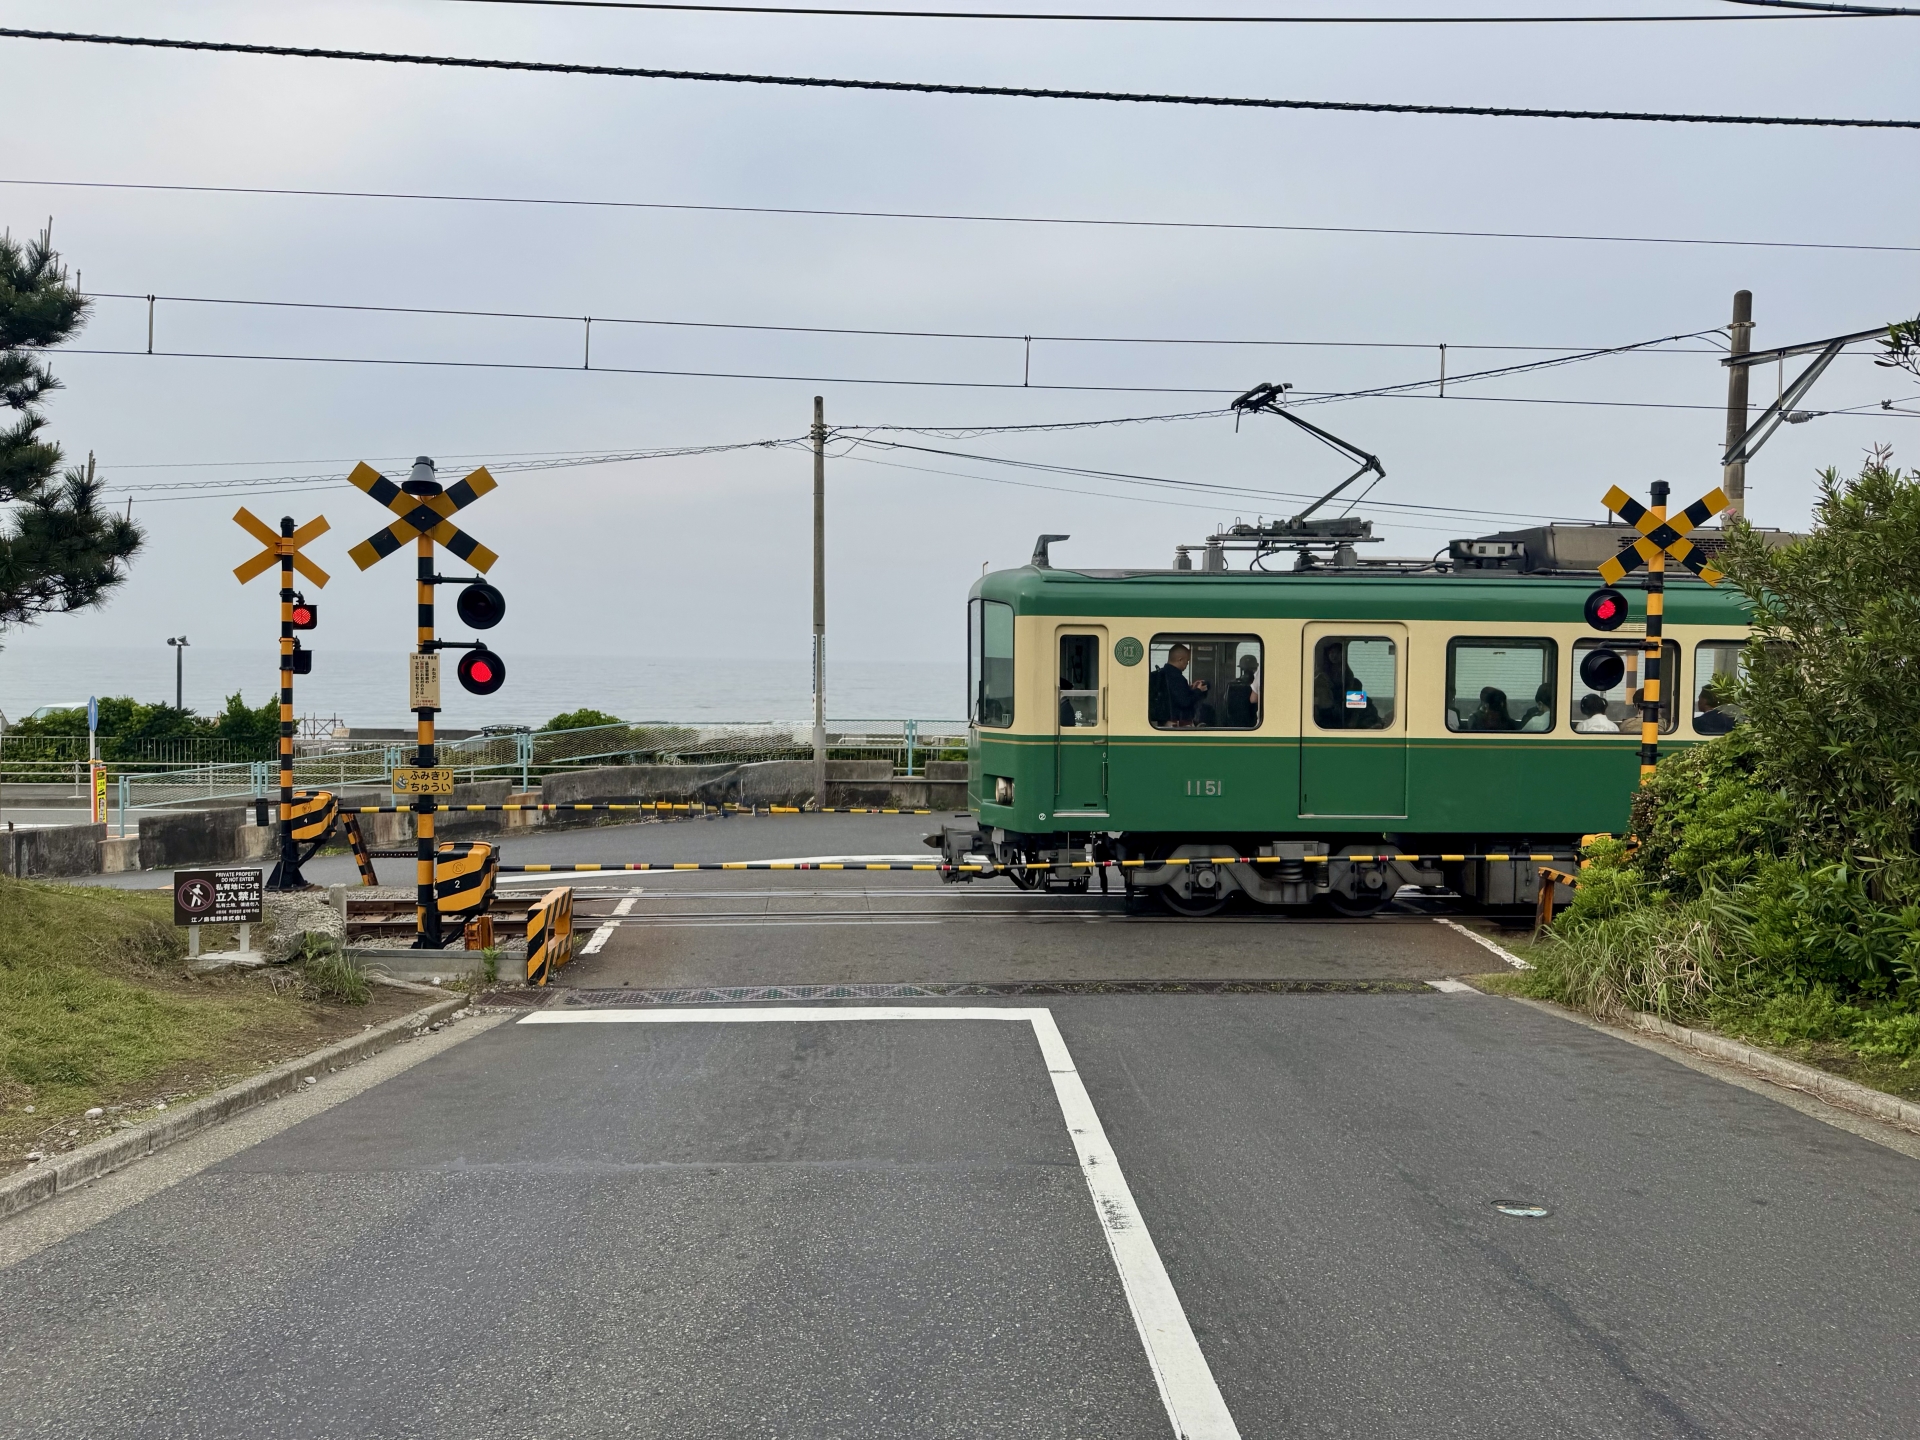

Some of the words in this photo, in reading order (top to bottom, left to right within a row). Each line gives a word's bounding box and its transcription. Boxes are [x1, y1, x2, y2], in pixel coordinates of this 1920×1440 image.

[410, 770, 450, 780] ふみきり
[410, 782, 451, 792] ちゅうい
[1187, 780, 1221, 796] 1151
[215, 882, 260, 890] 私有地につき
[454, 879, 461, 889] 2
[215, 890, 260, 902] 立入禁止
